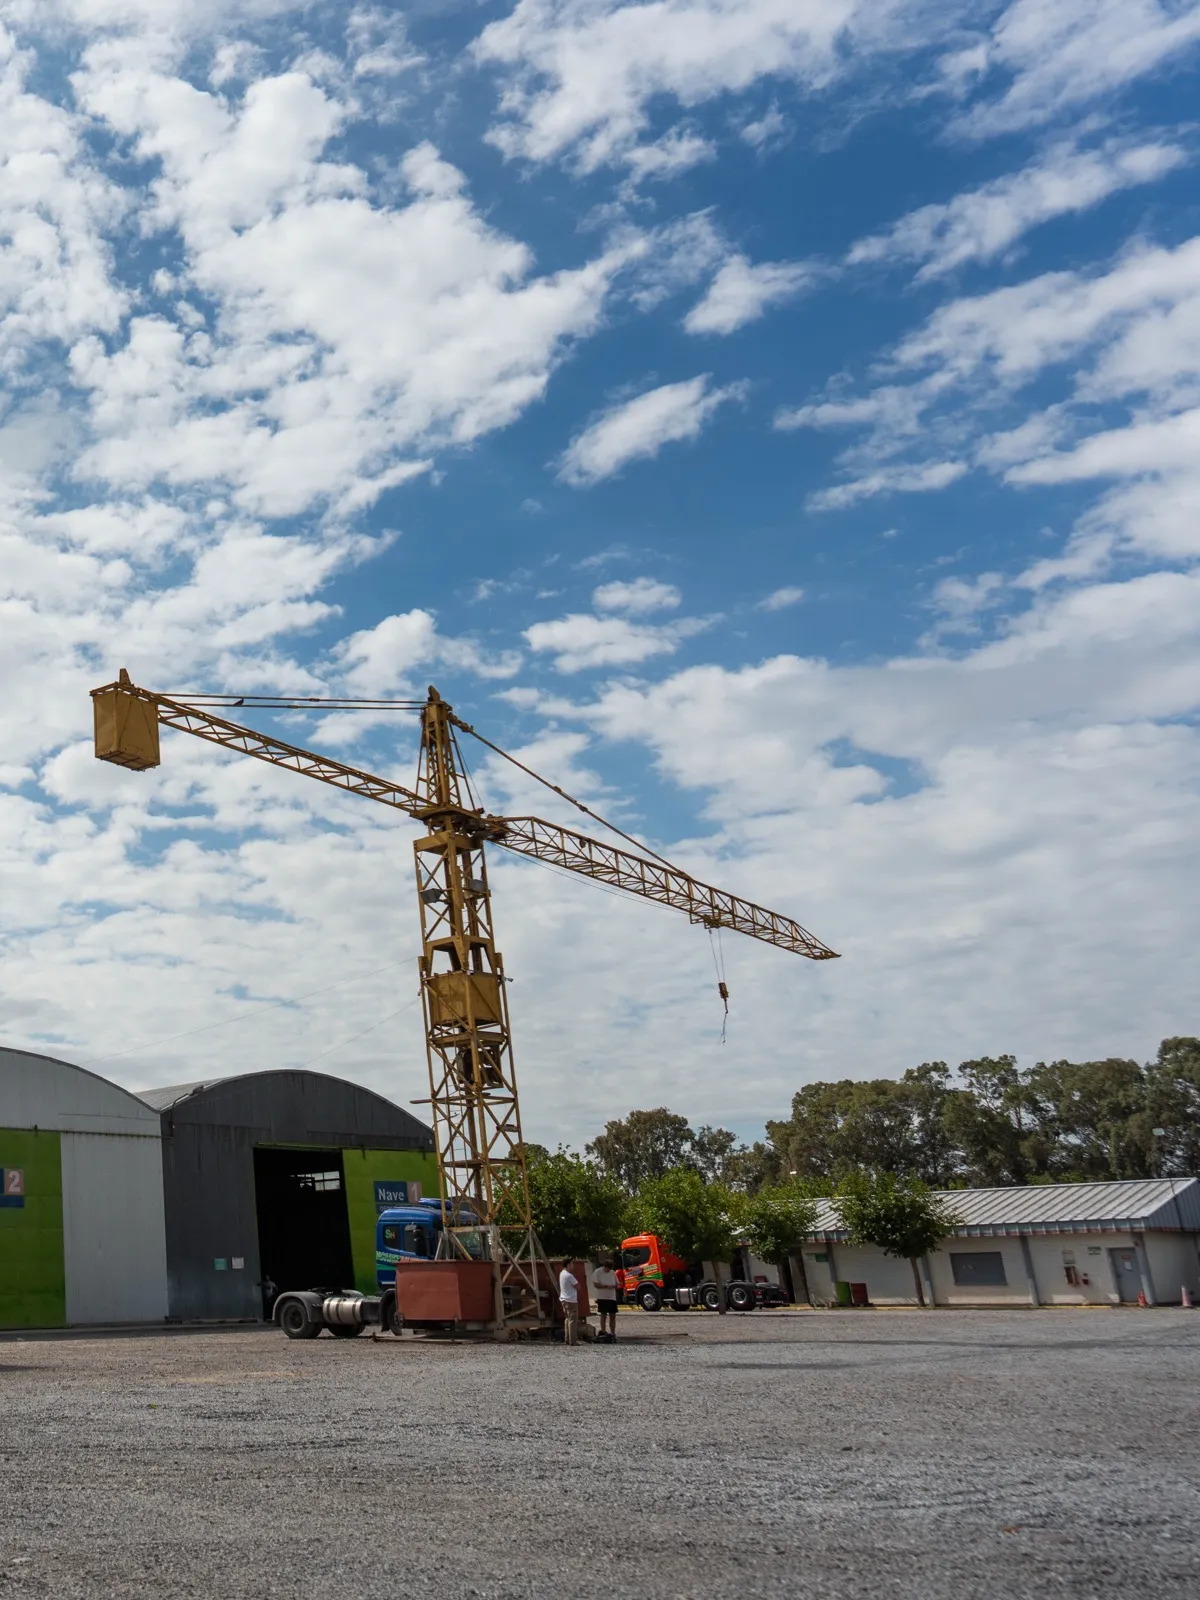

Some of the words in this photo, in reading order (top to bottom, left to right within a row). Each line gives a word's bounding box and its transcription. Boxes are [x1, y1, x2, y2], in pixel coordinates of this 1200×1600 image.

[8, 1170, 21, 1192] 2
[378, 1188, 404, 1201] Nave
[411, 1183, 418, 1201] 1
